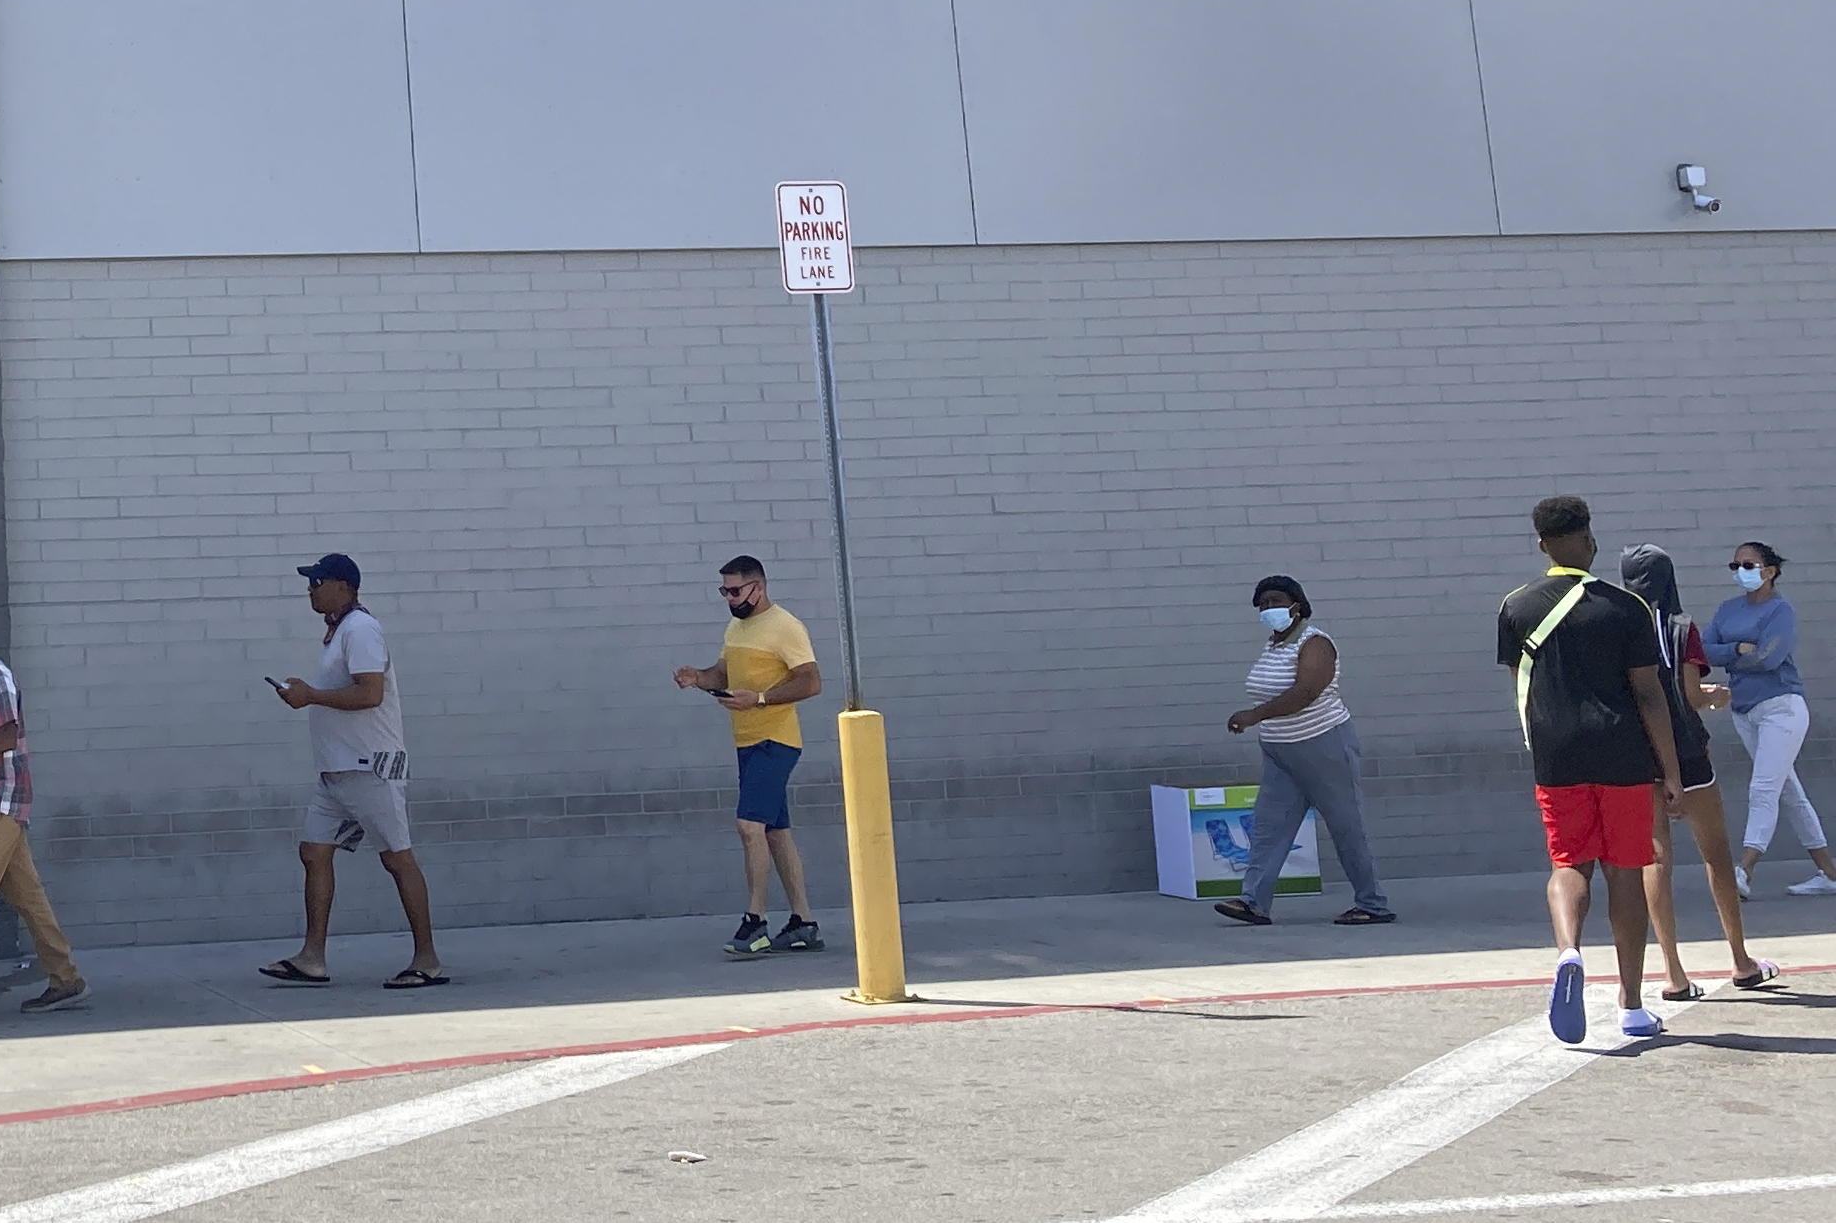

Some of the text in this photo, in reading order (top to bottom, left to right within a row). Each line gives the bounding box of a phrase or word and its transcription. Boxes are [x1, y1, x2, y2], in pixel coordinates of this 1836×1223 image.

[799, 195, 824, 215] NO
[784, 221, 844, 241] PARKING
[801, 247, 831, 260] FIRE
[800, 265, 835, 279] LANE
